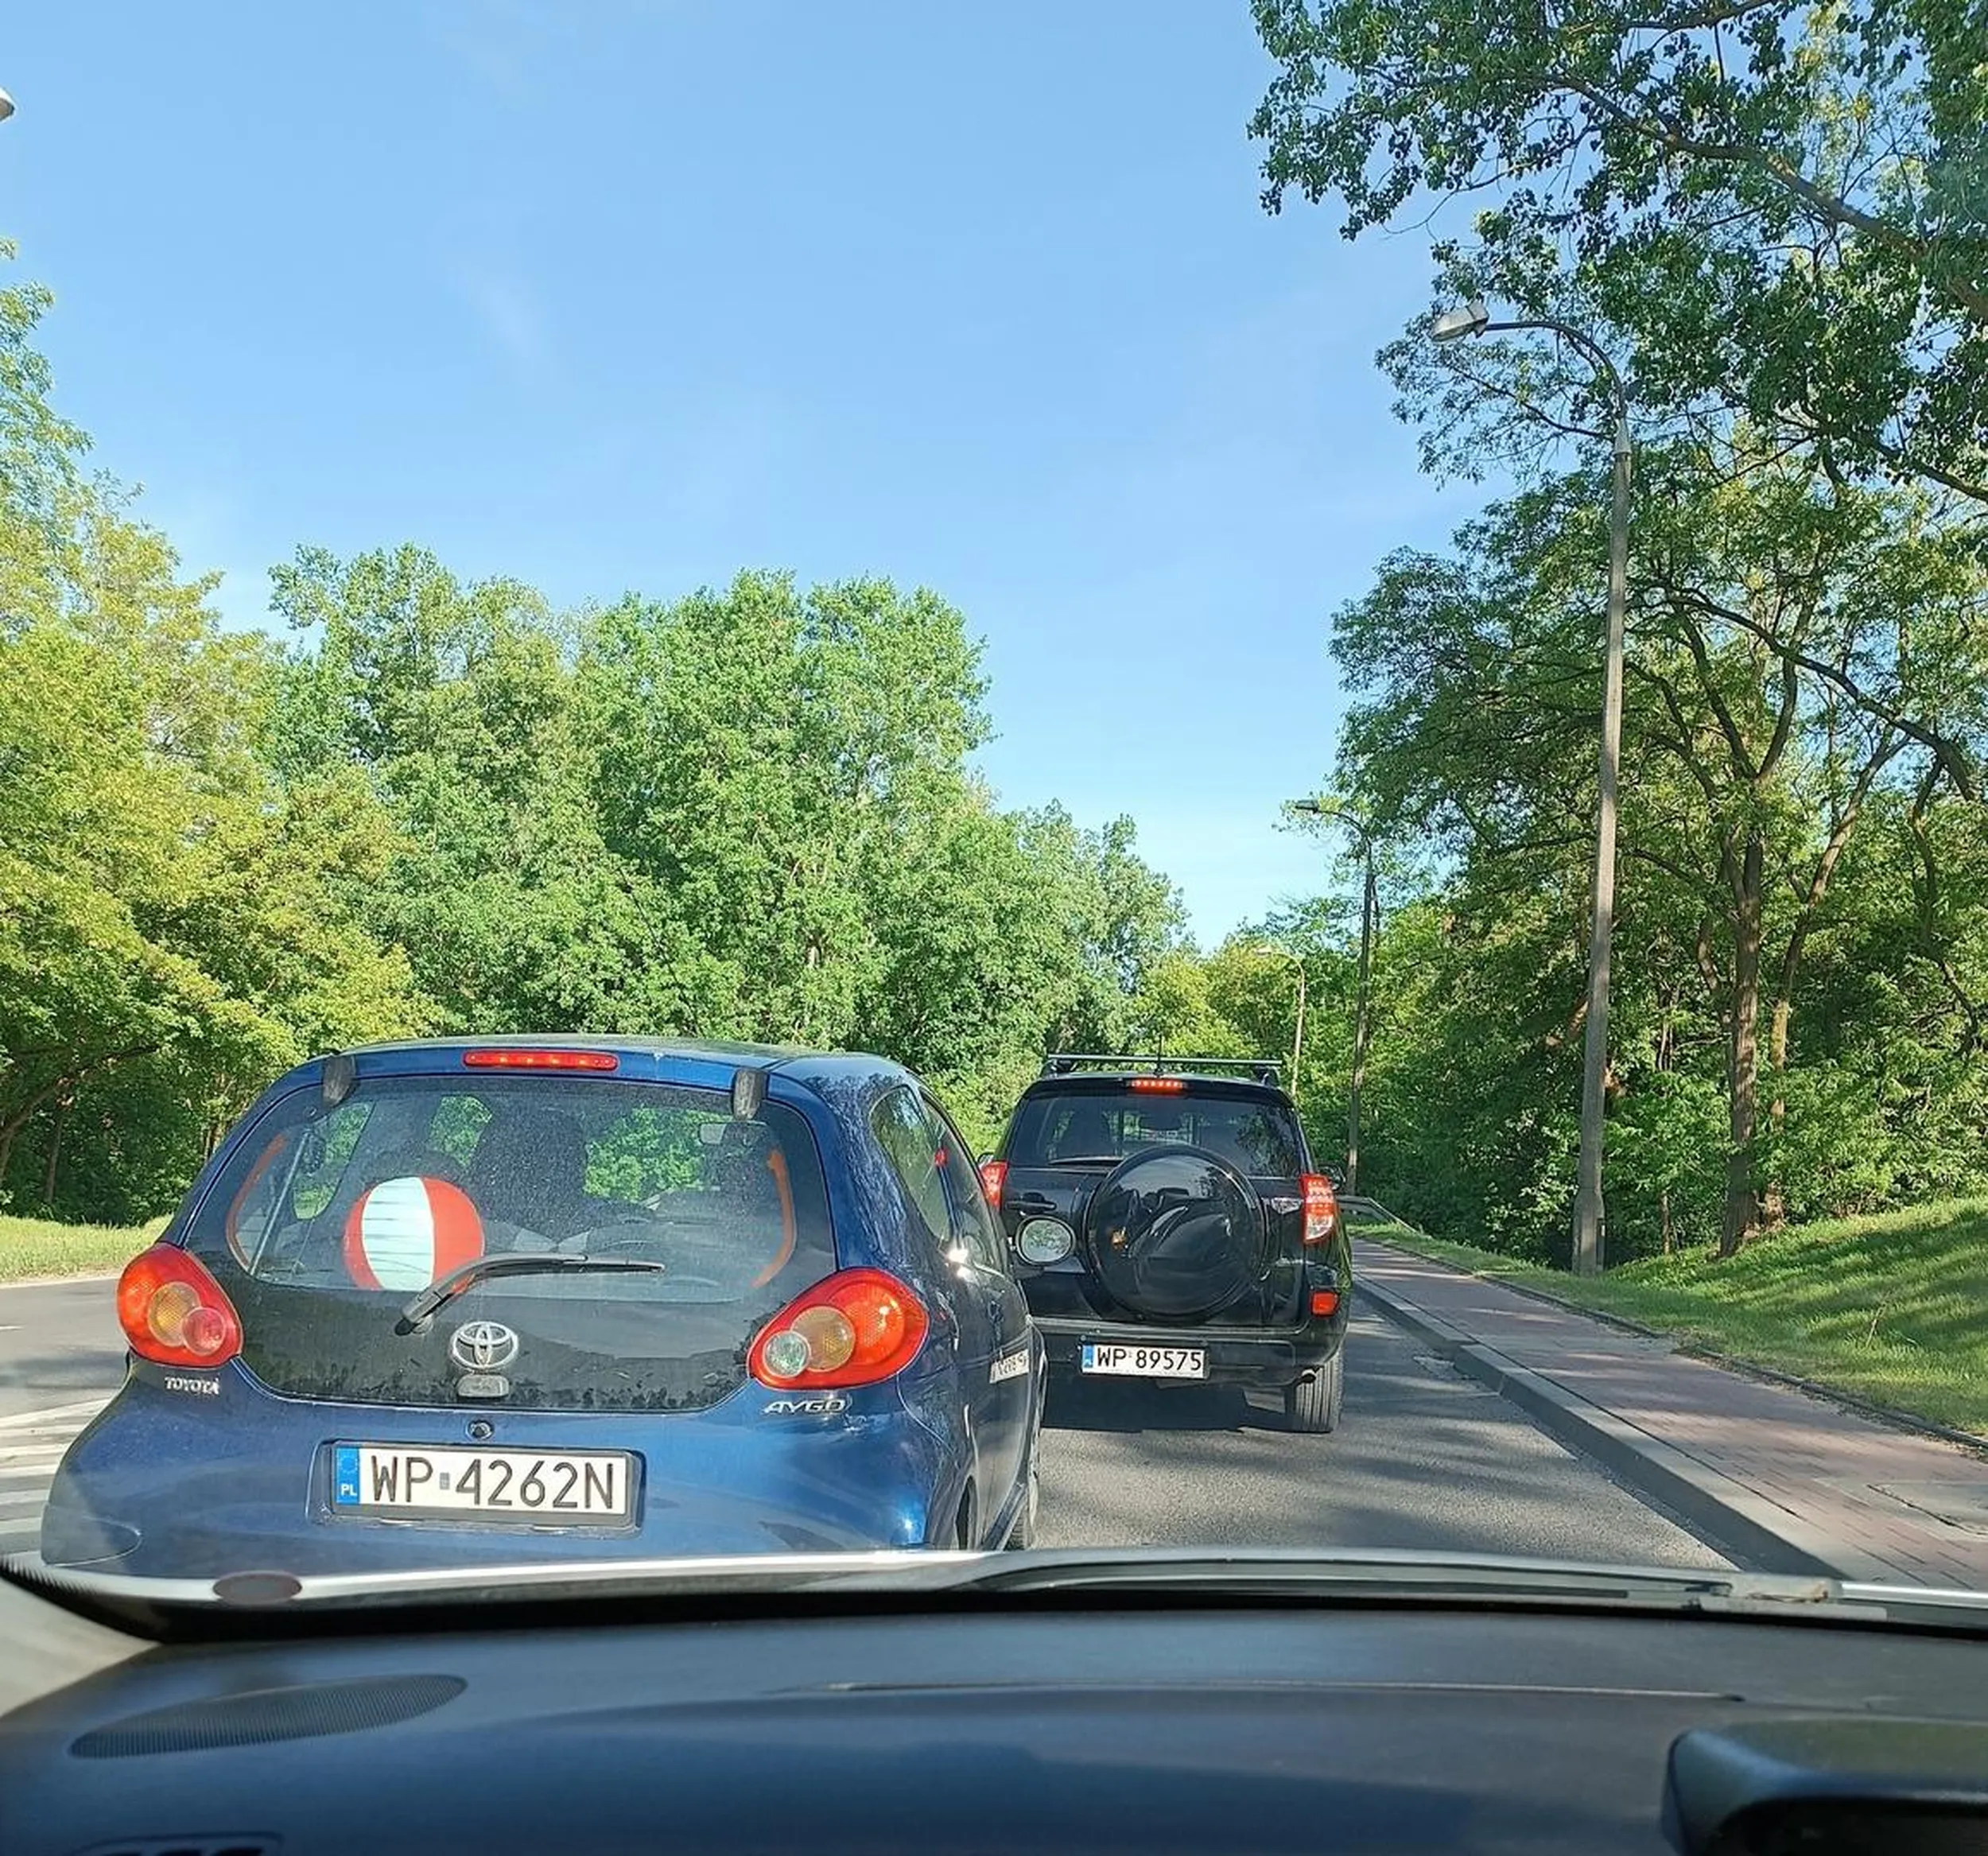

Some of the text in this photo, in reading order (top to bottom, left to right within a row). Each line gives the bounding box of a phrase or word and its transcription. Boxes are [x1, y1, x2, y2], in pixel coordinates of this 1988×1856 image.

[1097, 1347, 1127, 1367] WP
[1136, 1349, 1202, 1371] 89575
[164, 1376, 219, 1395] TOYOTA
[763, 1399, 846, 1414] AYGO
[340, 1483, 358, 1497] PL
[371, 1454, 614, 1509] WP 4262N
